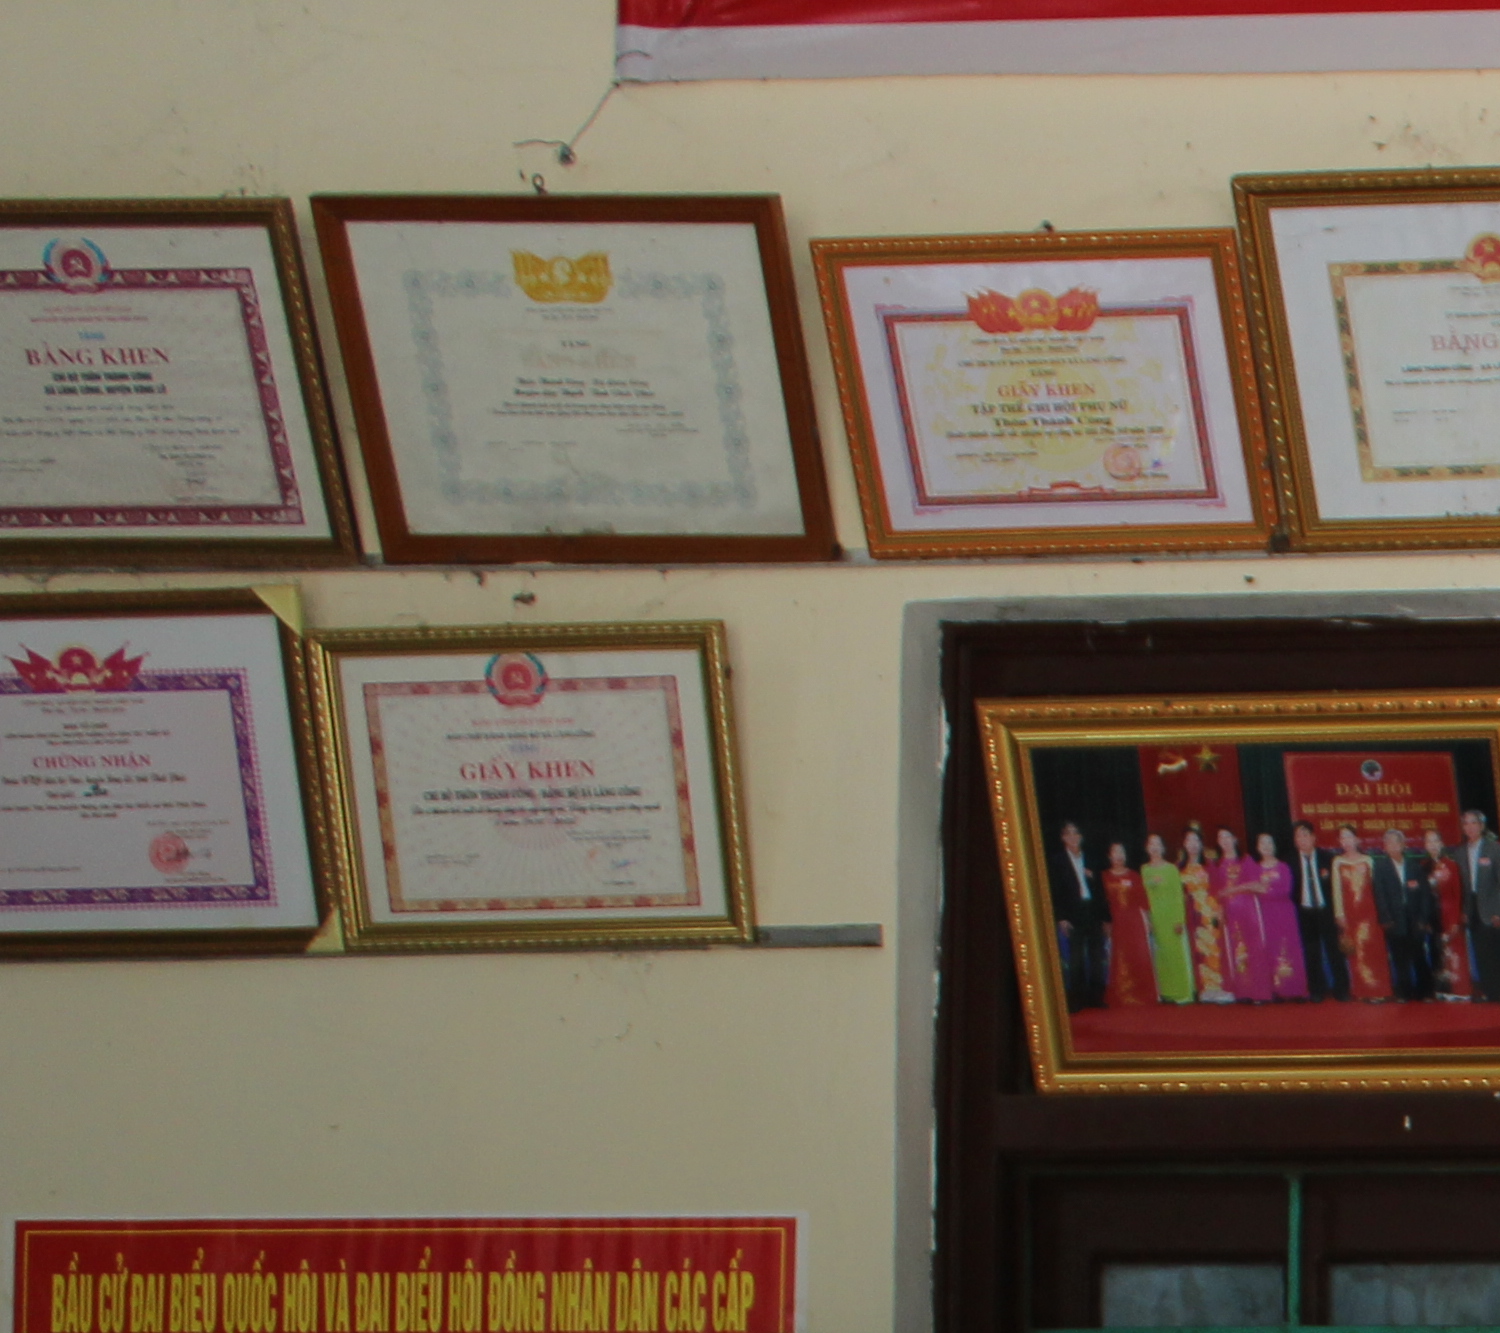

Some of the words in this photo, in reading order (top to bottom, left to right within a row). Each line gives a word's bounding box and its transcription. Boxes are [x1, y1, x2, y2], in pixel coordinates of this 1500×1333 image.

[25, 341, 94, 367] BẰNG
[100, 347, 171, 366] KHEN
[1046, 382, 1095, 398] KHEN
[459, 757, 519, 780] GIẤY
[528, 760, 596, 780] KHEN
[52, 1251, 93, 1333] BẦU
[99, 1251, 129, 1333] CỬ
[169, 1246, 218, 1333] BIỂU
[323, 1258, 350, 1333] VÀ
[395, 1245, 443, 1333] BIỂU
[487, 1250, 546, 1333] ĐỒNG
[550, 1257, 611, 1333] NHÂN
[615, 1257, 660, 1333] DÂN
[664, 1257, 707, 1333] CÁC
[712, 1248, 755, 1333] CẤP
